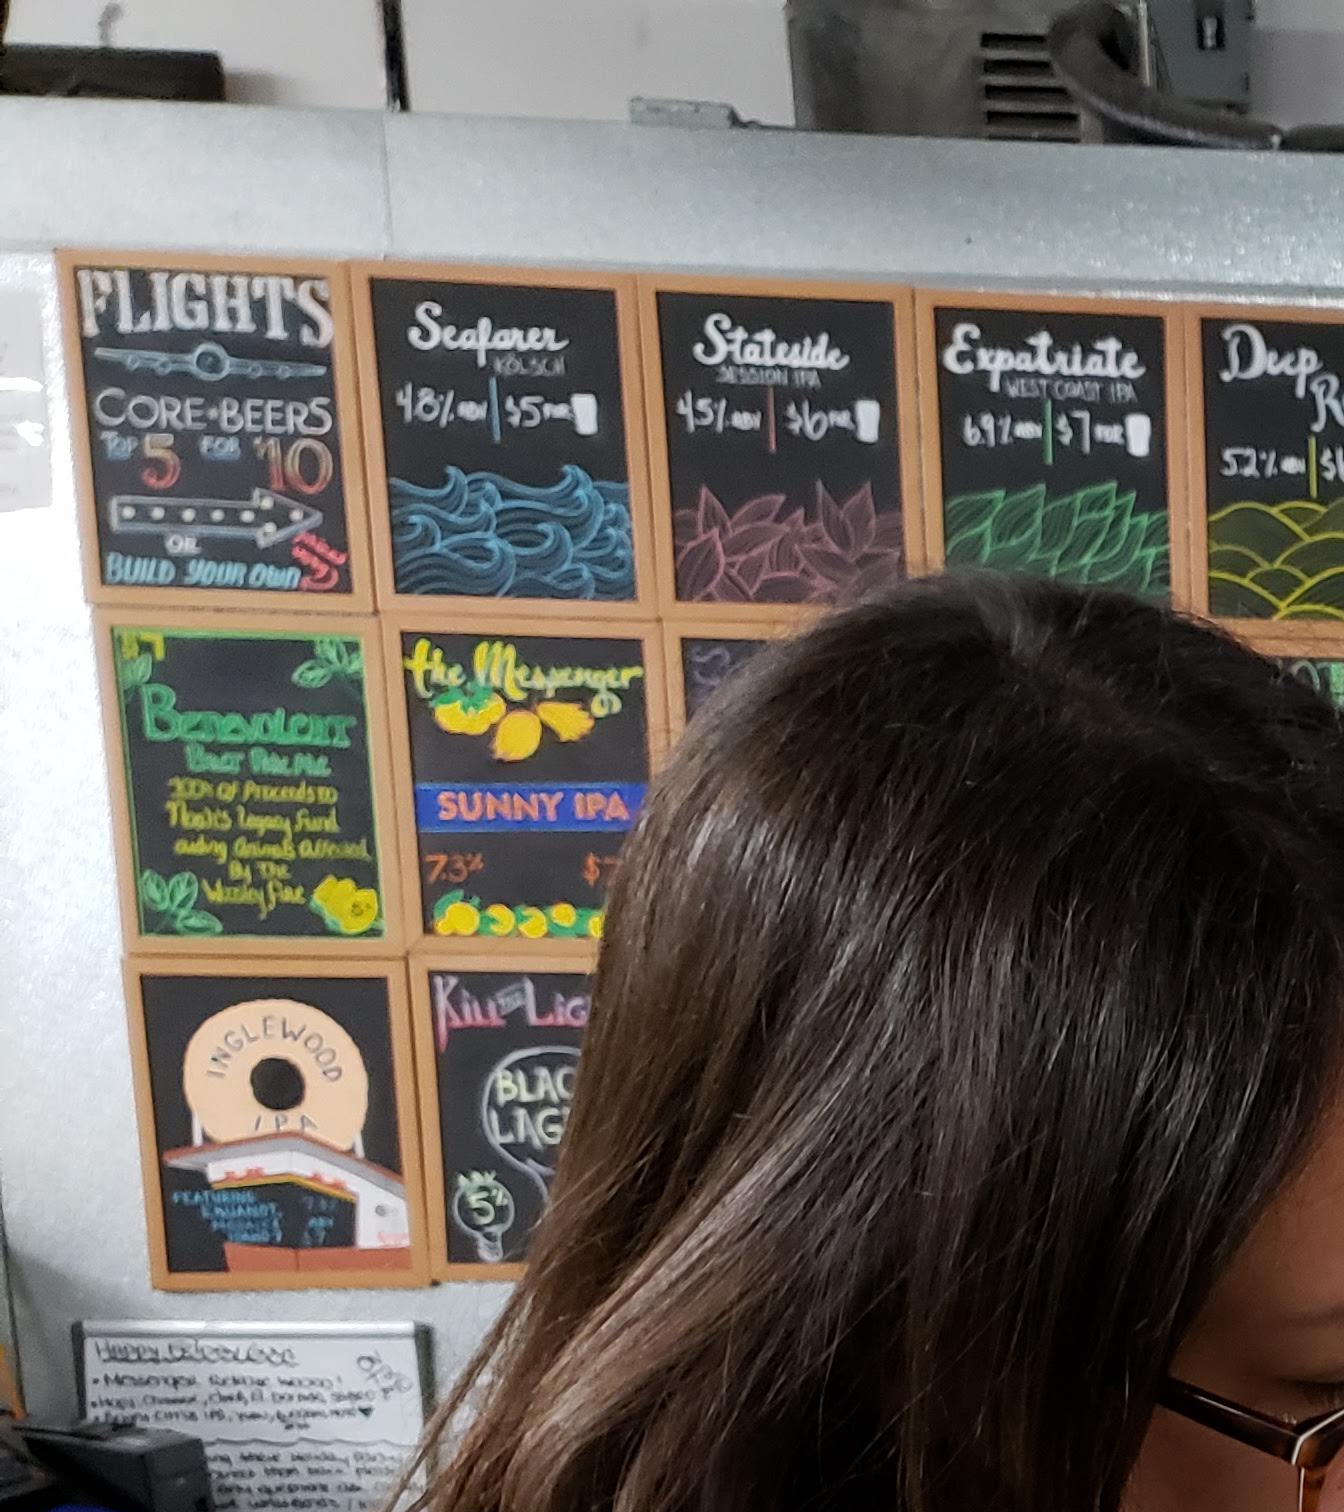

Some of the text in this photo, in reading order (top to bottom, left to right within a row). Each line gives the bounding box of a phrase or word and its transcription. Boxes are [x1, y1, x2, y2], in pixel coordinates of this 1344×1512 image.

[77, 269, 335, 348] FLIGHTS
[407, 299, 571, 369] Seafarer
[692, 312, 850, 371] Stateside
[942, 322, 1147, 393] Expatriate
[1219, 323, 1324, 399] Deep
[1005, 377, 1139, 404] WEST COAST IPA
[141, 433, 182, 490] 5
[200, 435, 242, 462] FOR
[105, 551, 303, 590] BUILD YOUR OWN
[472, 640, 645, 718] Messenger
[437, 790, 631, 822] SUNNY IPA
[206, 1014, 343, 1083] INGLEWOOD
[254, 1112, 319, 1134] IPA
[489, 1106, 572, 1150] LAG
